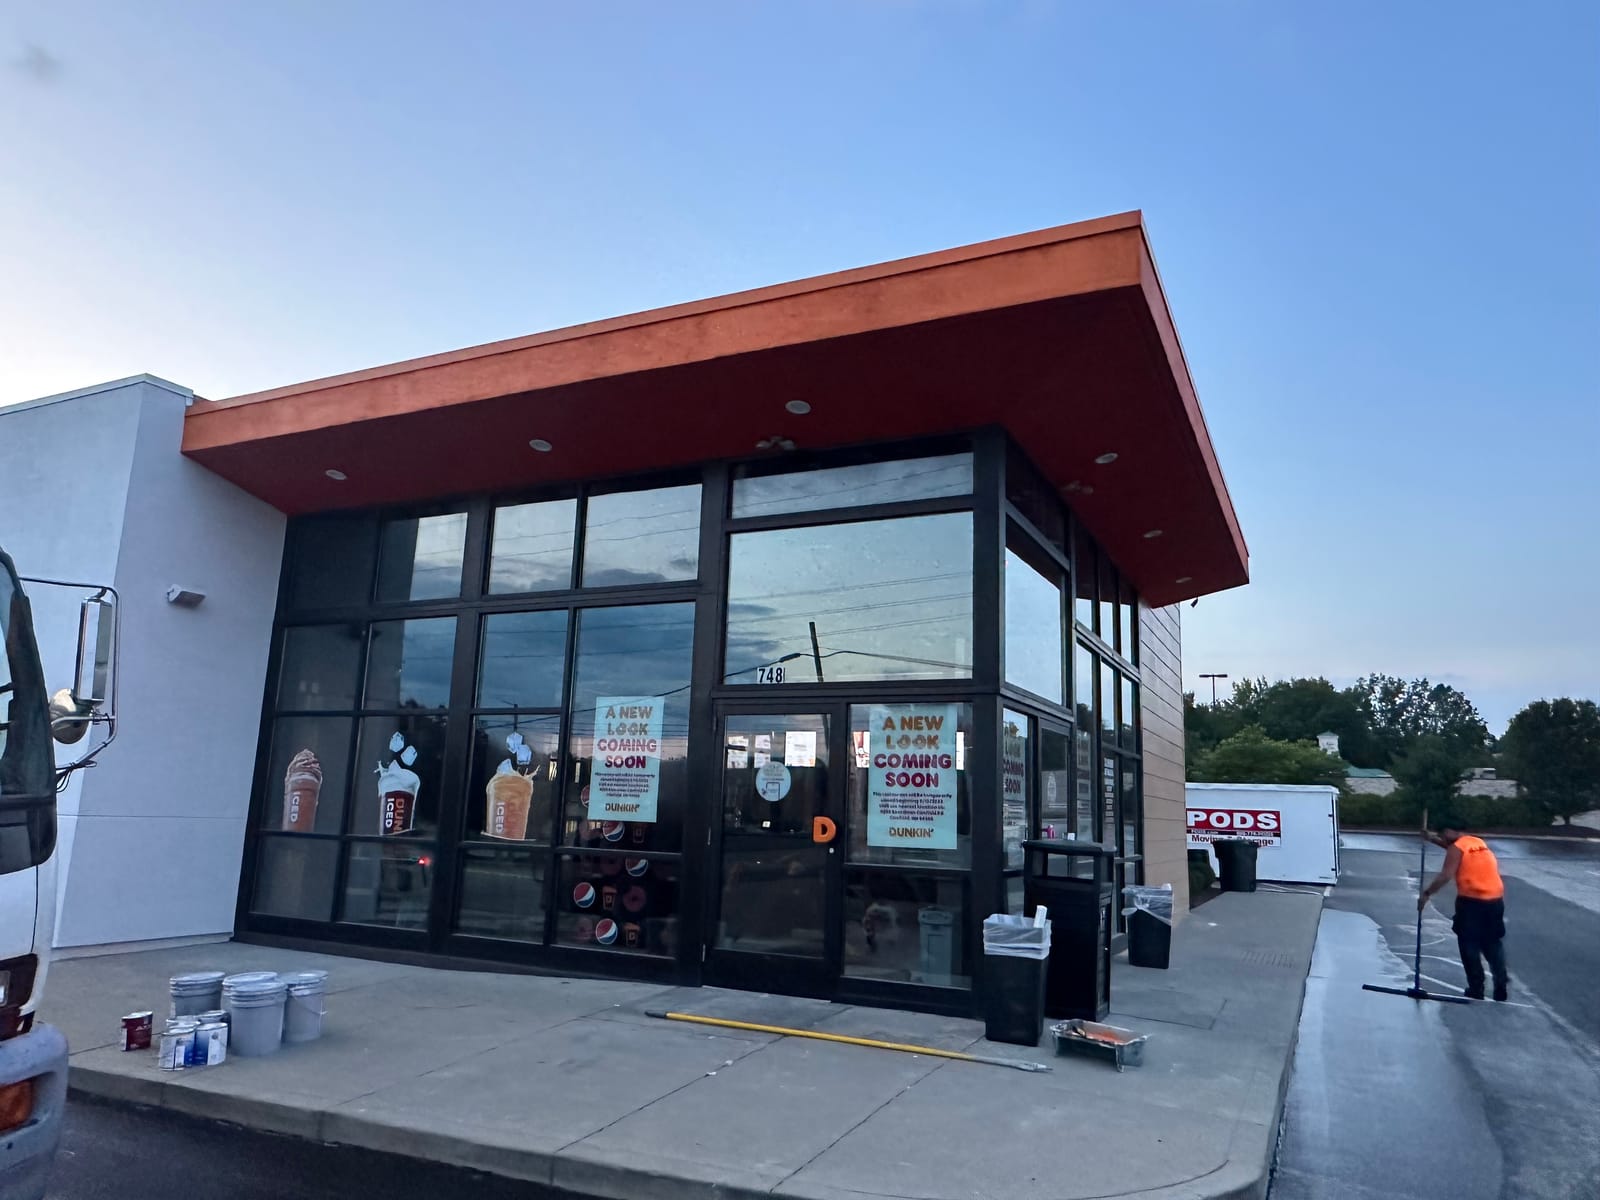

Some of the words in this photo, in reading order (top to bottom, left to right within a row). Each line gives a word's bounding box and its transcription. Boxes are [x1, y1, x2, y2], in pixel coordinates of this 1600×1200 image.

[758, 667, 783, 683] 748
[605, 706, 616, 719] A
[620, 706, 653, 719] NEW
[607, 722, 648, 736] LOOK
[882, 715, 896, 731] A
[900, 715, 944, 731] NEW
[597, 738, 657, 753] COMING
[886, 734, 940, 750] LOOK
[605, 755, 647, 769] SOON
[873, 753, 952, 769] COMING
[885, 771, 939, 788] SOON
[290, 791, 301, 822] ICED
[385, 797, 395, 828] ICED
[495, 802, 505, 833] ICED
[1186, 810, 1279, 830] PODS
[812, 815, 837, 843] D
